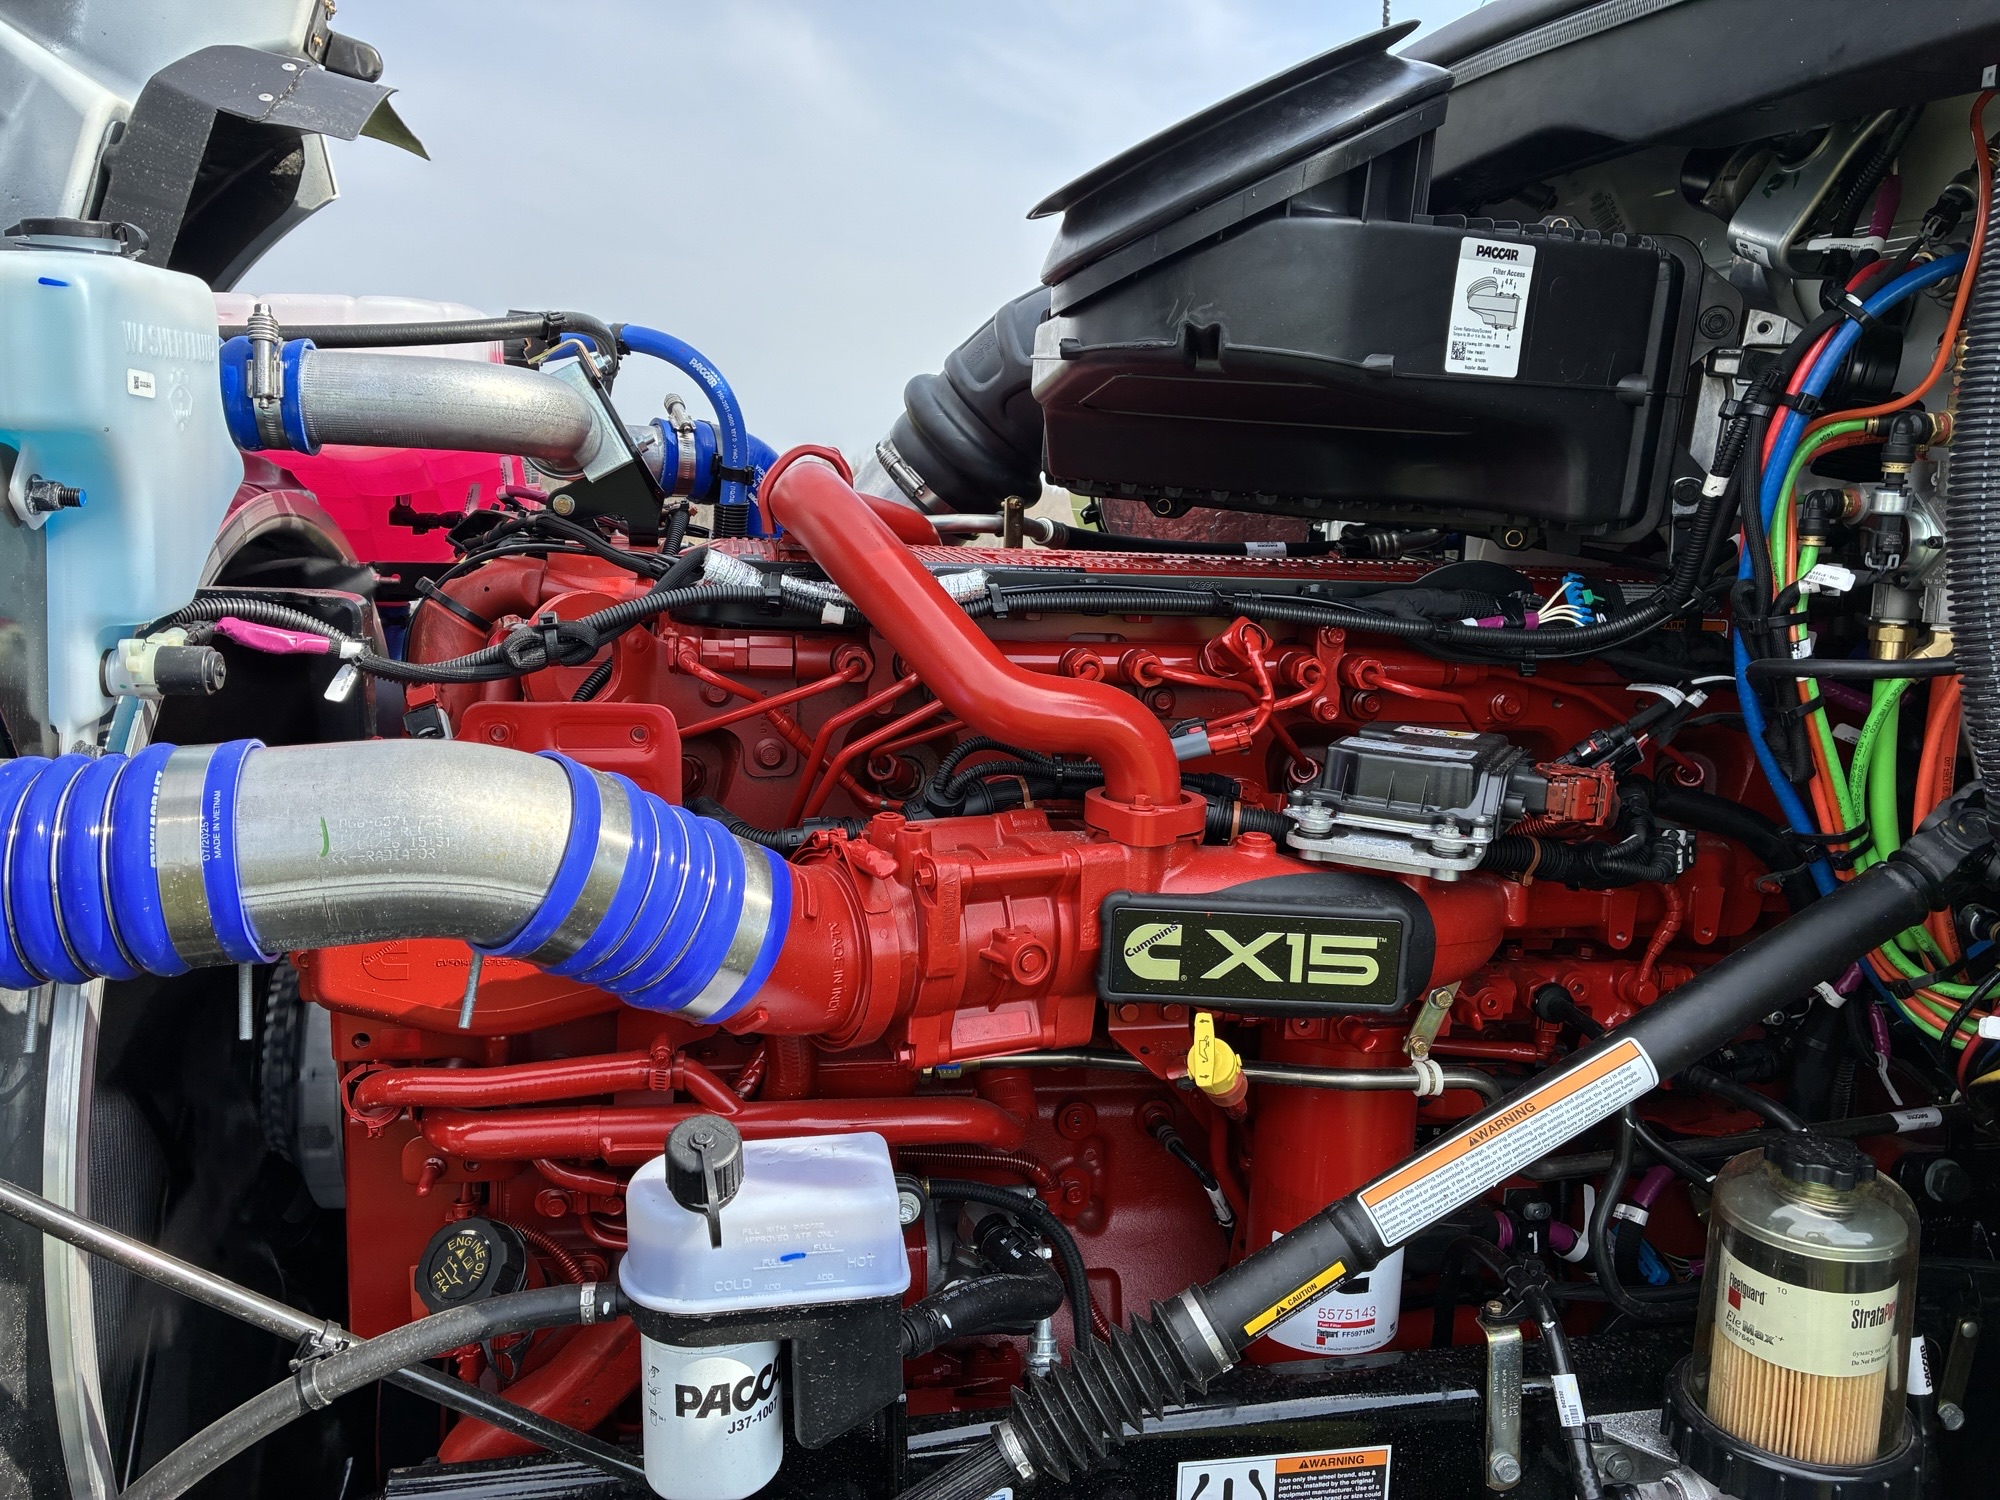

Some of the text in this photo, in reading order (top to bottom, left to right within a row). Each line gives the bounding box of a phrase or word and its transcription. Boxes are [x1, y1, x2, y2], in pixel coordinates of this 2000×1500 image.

[1476, 245, 1519, 261] PACCAR
[1492, 267, 1526, 278] Filter Access
[1509, 278, 1513, 286] X
[689, 357, 718, 388] PACCAR
[213, 790, 222, 859] MADE IN VIETNAM
[202, 821, 211, 862] 07/2025
[828, 922, 845, 968] MADE
[1124, 922, 1179, 959] Cummins
[1200, 928, 1380, 987] X15
[833, 969, 844, 984] IN
[1474, 1102, 1537, 1142] WARNING
[1377, 1203, 1389, 1212] any
[1387, 1196, 1399, 1207] part
[1398, 1192, 1406, 1200] of
[1404, 1187, 1415, 1196] the
[1414, 1175, 1436, 1192] steering
[1435, 1165, 1455, 1180] system
[1453, 1158, 1466, 1169] (e.g.
[1465, 1147, 1487, 1163] linkage,
[1485, 1135, 1508, 1151] steering
[1507, 1122, 1531, 1139] driveline,
[1530, 1111, 1551, 1126] column,
[1550, 1097, 1574, 1114] front-end
[1574, 1083, 1601, 1101] alignment,
[1600, 1076, 1613, 1087] etc.)
[1617, 1064, 1633, 1076] either
[1377, 1204, 1401, 1221] repaired,
[1400, 1191, 1423, 1208] removed
[1429, 1168, 1464, 1191] disassembled
[1469, 1160, 1480, 1169] any
[1479, 1153, 1493, 1164] way,
[1502, 1141, 1512, 1150] the
[1512, 1129, 1533, 1145] steering
[1533, 1121, 1548, 1133] angle
[1548, 1112, 1565, 1124] sensor
[1570, 1095, 1594, 1112] replaced,
[1593, 1090, 1603, 1098] the
[1602, 1079, 1624, 1094] steering
[1623, 1070, 1638, 1082] angle
[1381, 1214, 1399, 1227] sensor
[1398, 1205, 1412, 1217] must
[1412, 1201, 1420, 1209] be
[1419, 1184, 1452, 1205] recalibrated.
[1455, 1176, 1465, 1184] the
[1465, 1158, 1497, 1179] recalibration
[1501, 1149, 1511, 1158] not
[1511, 1135, 1538, 1154] performed
[1537, 1129, 1547, 1138] the
[1546, 1118, 1567, 1134] stability
[1566, 1108, 1585, 1121] control
[1585, 1098, 1604, 1112] system
[1602, 1092, 1613, 1101] will
[1612, 1087, 1621, 1095] not
[1621, 1076, 1642, 1090] function
[742, 1227, 760, 1236] FILL
[766, 1225, 787, 1234] WITH
[744, 1229, 840, 1244] APPROVED ATF ONLY
[813, 1243, 835, 1251] FULL
[447, 1236, 486, 1282] ENGINE OIL
[847, 1254, 876, 1269] HOT
[432, 1271, 450, 1293] FA4
[714, 1278, 753, 1292] COLD
[816, 1273, 834, 1281] ADD
[763, 1283, 781, 1291] ADD
[1287, 1283, 1318, 1306] CAUTION
[1729, 1271, 1766, 1306] Fleetguard
[1777, 1286, 1788, 1296] 10
[1850, 1299, 1860, 1307] 10
[1318, 1306, 1377, 1320] 5575143
[1342, 1328, 1376, 1338] FF5971NN
[1725, 1321, 1756, 1347] FS19764G
[1919, 1344, 1932, 1388] PACCAR
[674, 1351, 781, 1419] PACCA
[727, 1396, 778, 1434] J37-1007
[1308, 1454, 1365, 1468] WARNING
[1278, 1484, 1291, 1492] part
[1303, 1480, 1329, 1489] installed
[1329, 1479, 1338, 1487] by
[1350, 1476, 1374, 1485] original
[1291, 1475, 1306, 1484] only
[1317, 1472, 1336, 1480] wheel
[1336, 1470, 1357, 1479] brand,
[1277, 1489, 1311, 1499] equipment
[1311, 1486, 1353, 1495] manufacturer.
[1363, 1490, 1381, 1498] could
